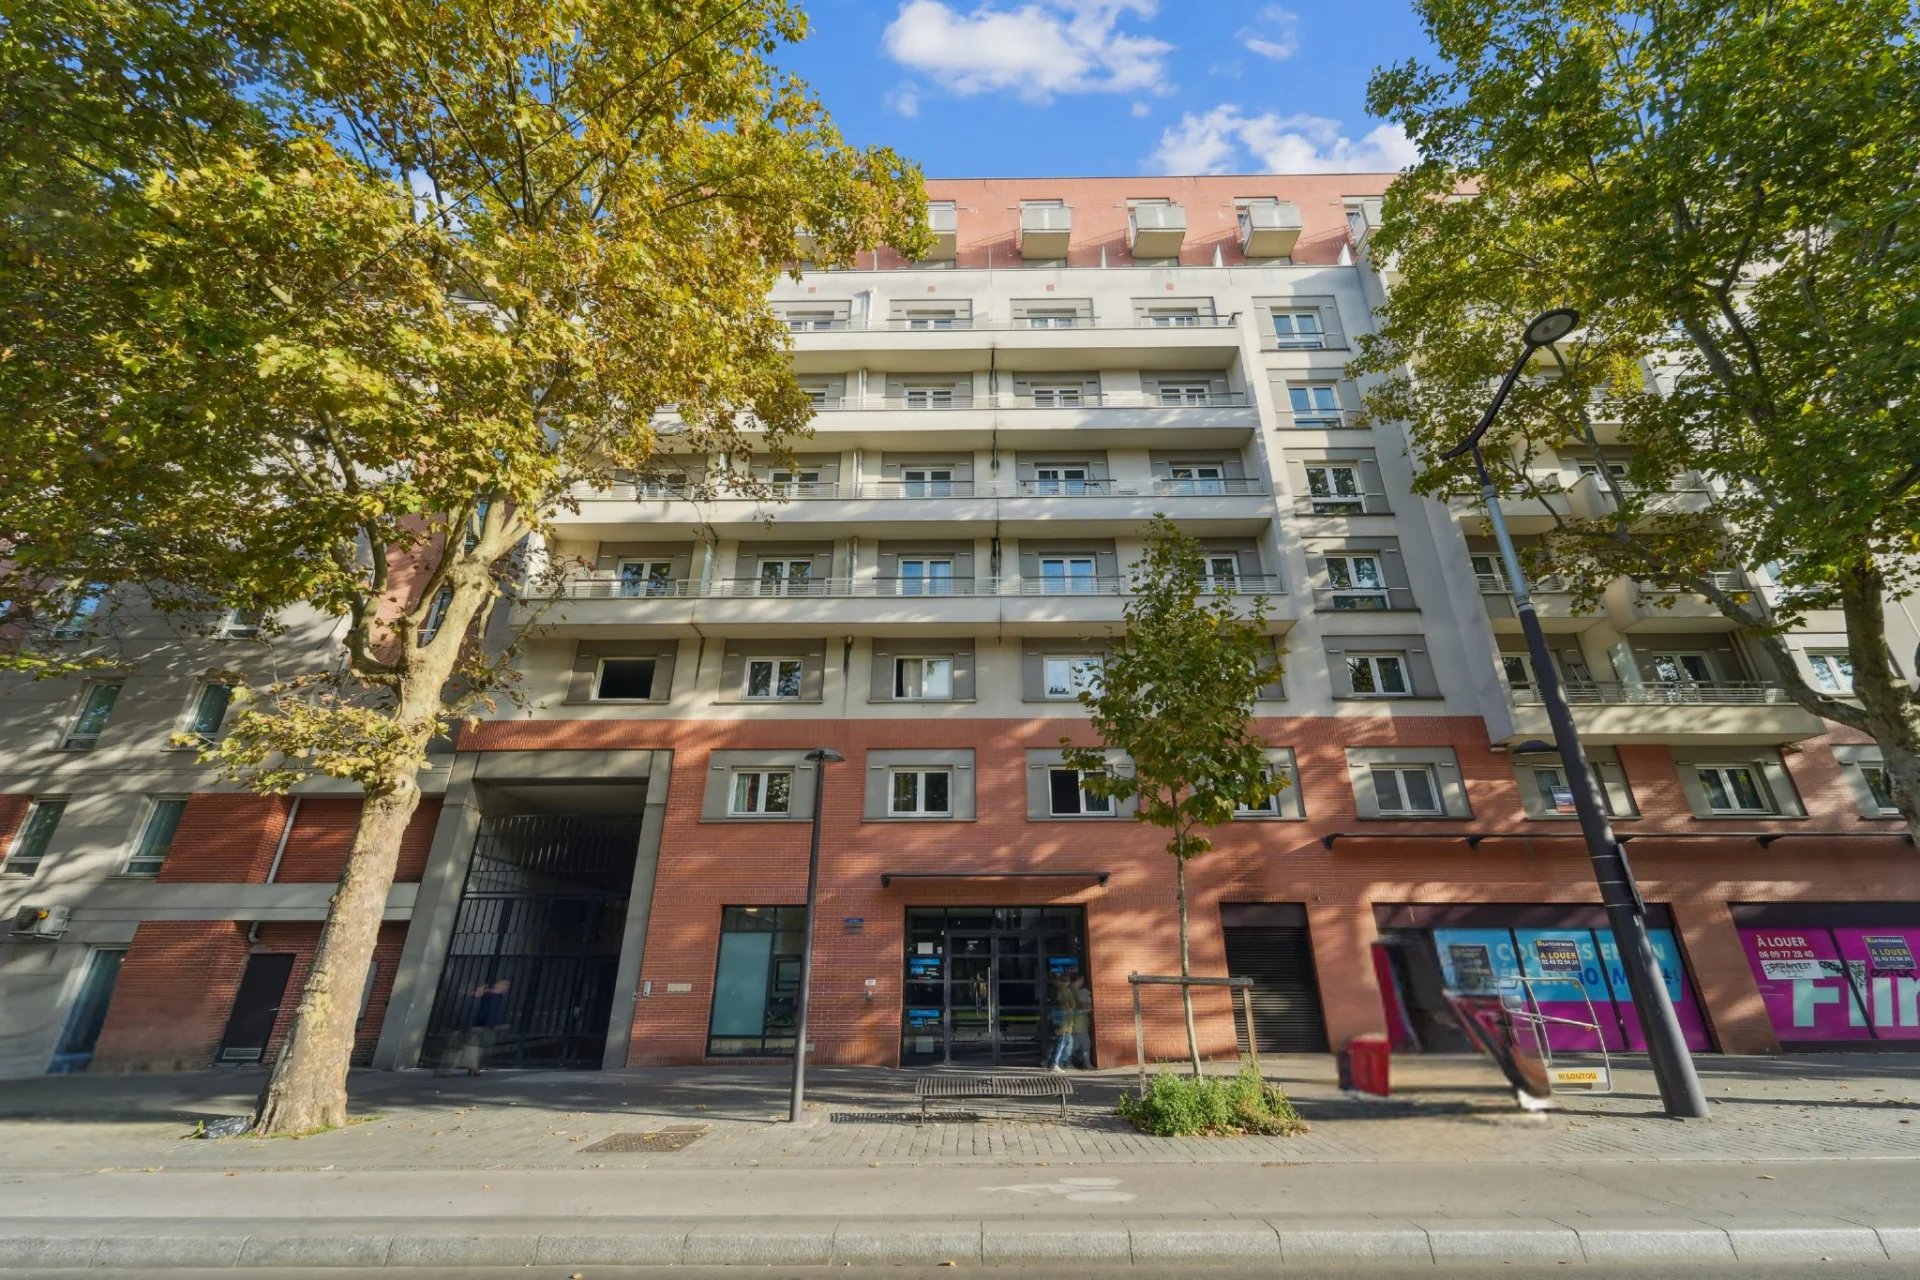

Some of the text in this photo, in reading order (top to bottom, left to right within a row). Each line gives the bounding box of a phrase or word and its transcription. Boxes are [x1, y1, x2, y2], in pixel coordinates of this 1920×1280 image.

[1755, 934, 1808, 947] À LOUER
[1758, 950, 1814, 958] 06 09 77 28 40
[1879, 948, 1909, 956] LOUER
